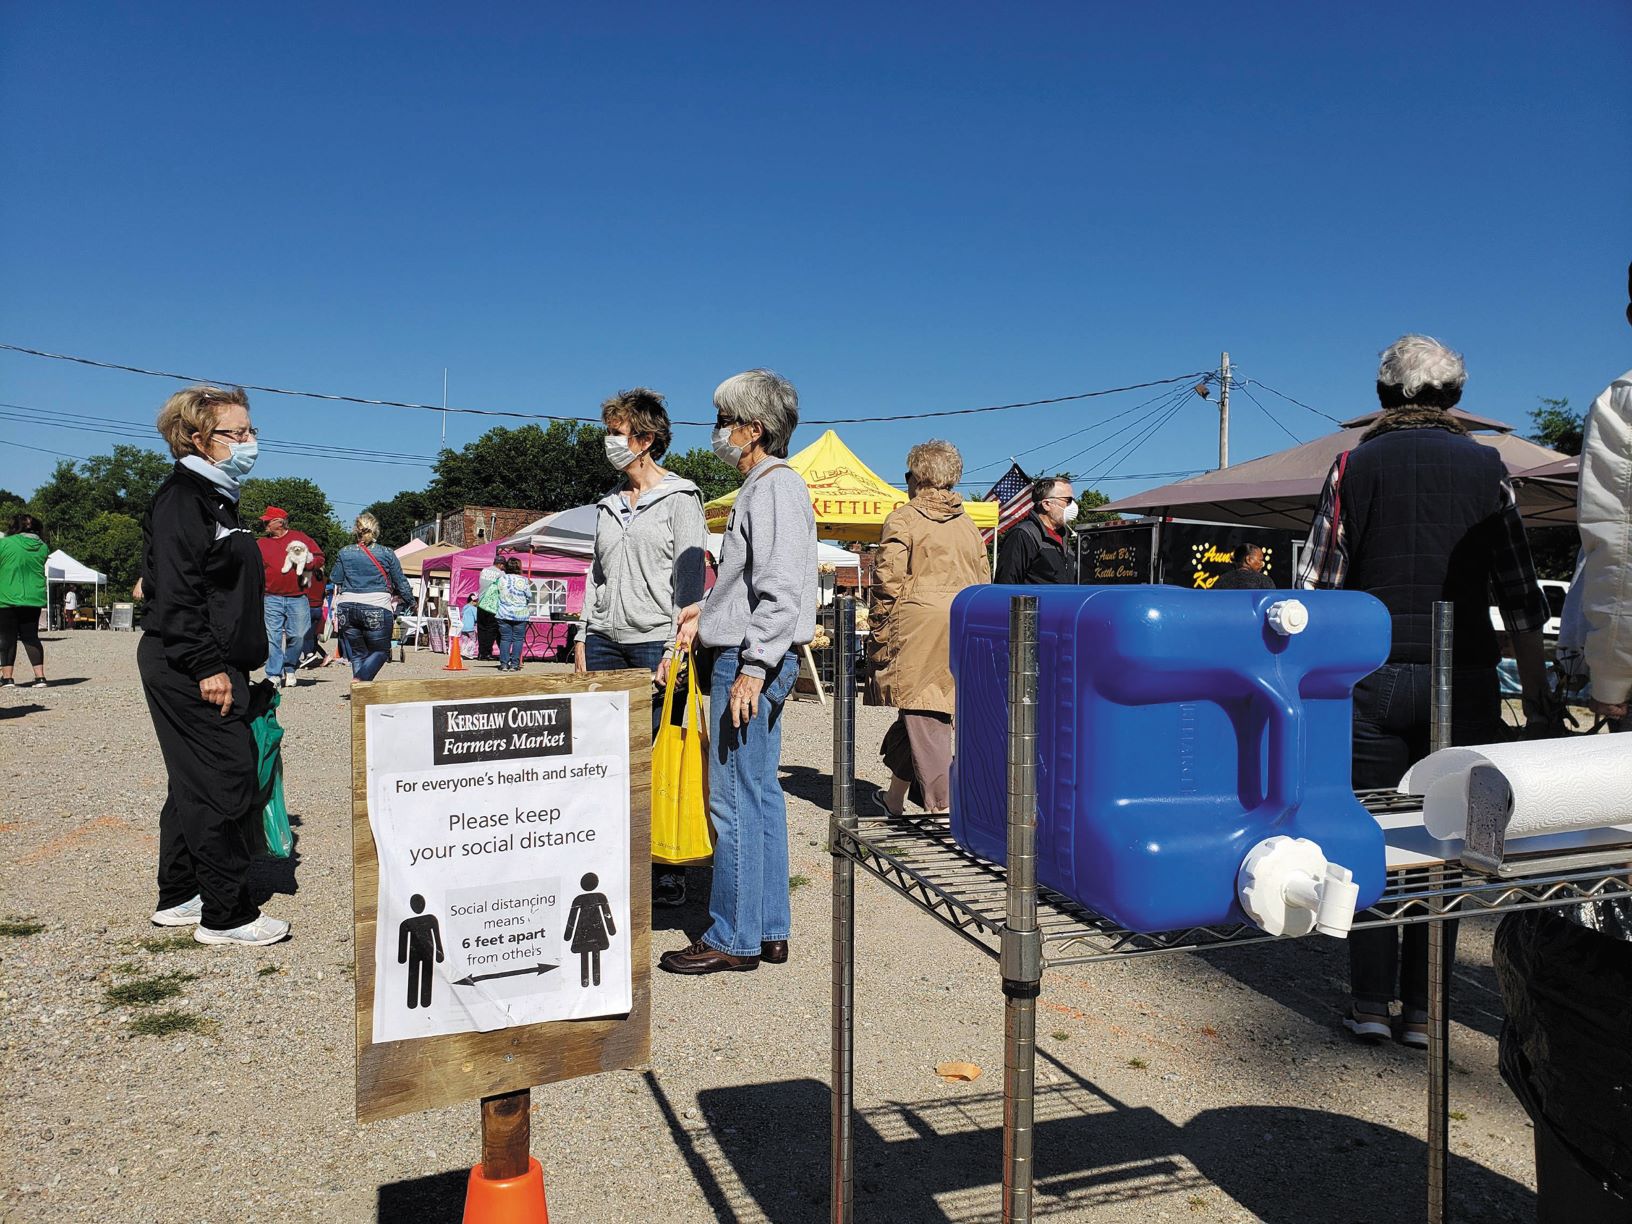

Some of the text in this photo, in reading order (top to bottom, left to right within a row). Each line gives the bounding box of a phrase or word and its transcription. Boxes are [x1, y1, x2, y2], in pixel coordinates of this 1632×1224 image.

[812, 498, 881, 517] KETTLE
[442, 731, 566, 756] Farmers Market
[395, 780, 418, 794] For
[497, 768, 539, 786] health
[542, 765, 567, 781] and
[570, 762, 609, 779] safety
[448, 807, 562, 832] Please keep
[408, 828, 597, 867] your social distance
[450, 894, 557, 917] Social distancing
[484, 915, 526, 930] means
[462, 928, 546, 949] 6 feet apart
[466, 946, 542, 966] from others
